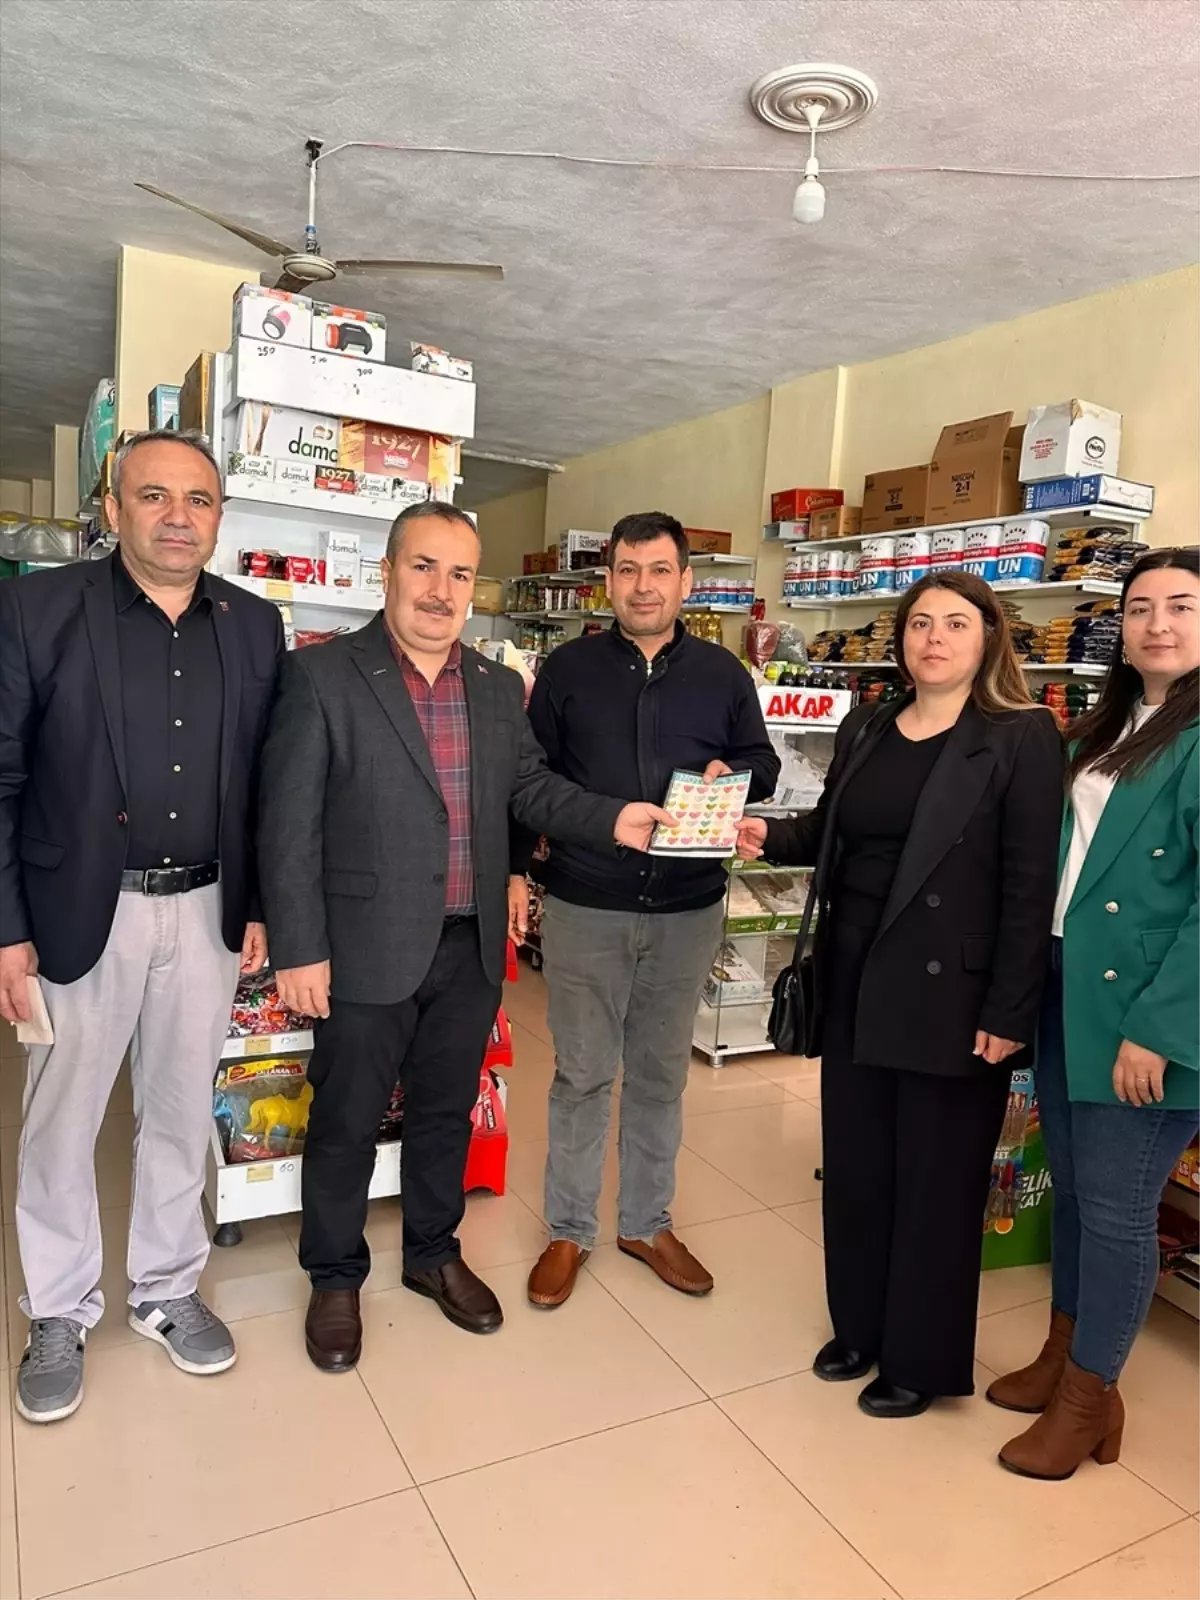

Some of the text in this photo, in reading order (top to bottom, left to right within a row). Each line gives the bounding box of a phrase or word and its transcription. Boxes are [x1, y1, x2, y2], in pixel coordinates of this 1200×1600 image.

[240, 462, 268, 478] damok
[281, 466, 310, 483] damok
[321, 467, 350, 483] 1927
[360, 477, 387, 493] damok
[329, 539, 358, 554] damok
[766, 693, 834, 718] AKAR
